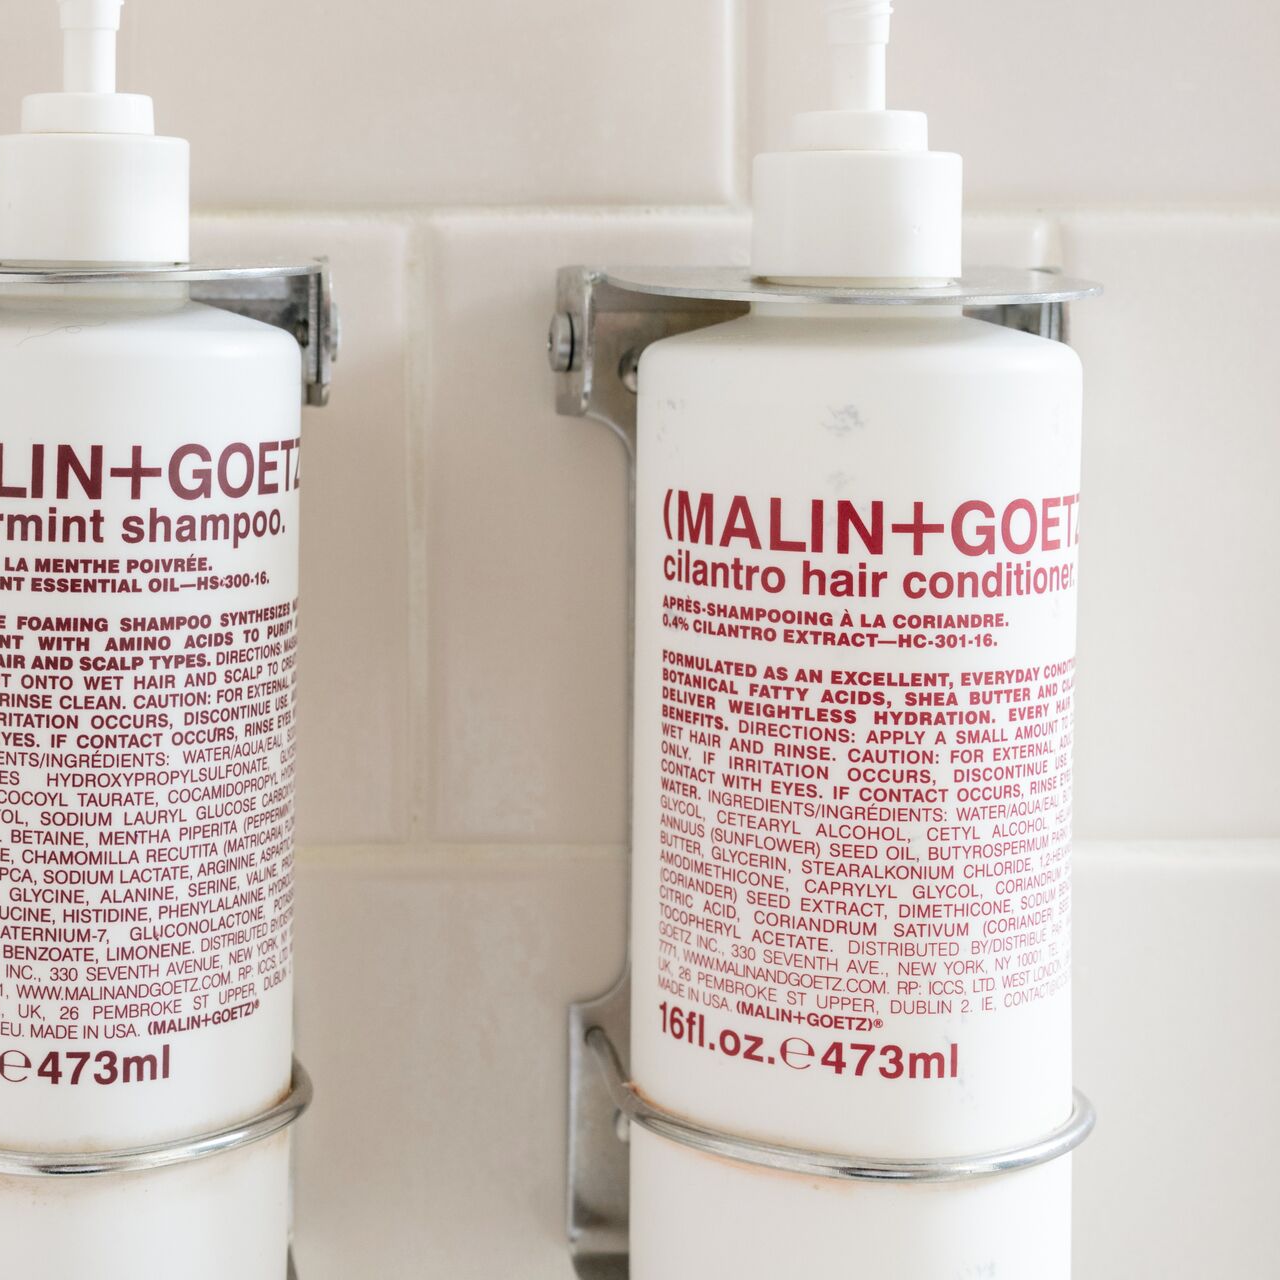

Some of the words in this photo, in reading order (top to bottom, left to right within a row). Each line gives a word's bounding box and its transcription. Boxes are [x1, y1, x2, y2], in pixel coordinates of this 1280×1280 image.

[121, 507, 286, 550] shampoo.
[4, 556, 29, 573] LA
[34, 558, 120, 574] MENTHE
[126, 553, 213, 574] POIVRÉE.
[663, 548, 786, 594] cilantro
[802, 559, 888, 598] hair
[30, 577, 143, 594] ESSENTIAL
[16, 615, 109, 633] FOAMING
[119, 614, 212, 633] SHAMPOO
[219, 601, 291, 628] SYNTHESIZES
[662, 594, 833, 627] APRÈS-SHAMPOOING
[839, 608, 854, 628] À
[860, 613, 887, 629] LA
[892, 612, 1009, 630] CORIANDRE.
[662, 612, 690, 632] 0.4%
[692, 618, 777, 643] CILANTRO
[37, 635, 90, 652] WITH
[104, 635, 172, 652] AMINO
[183, 631, 234, 650] ACIDS
[242, 627, 260, 644] TO
[267, 618, 293, 640] PURIFY
[30, 655, 74, 671] AND
[79, 656, 144, 672] SCALP
[148, 652, 211, 671] TYPES.
[216, 641, 282, 666] DIRECTIONS:
[662, 648, 758, 678] FORMULATED
[763, 665, 789, 682] AS
[794, 668, 823, 684] AN
[830, 670, 954, 690] EXCELLENT,
[960, 666, 1040, 687] EVERYDAY
[59, 695, 126, 711] CLEAN.
[133, 690, 211, 710] CAUTION:
[216, 686, 243, 704] FOR
[662, 667, 739, 696] BOTANICAL
[749, 682, 809, 702] FATTY
[820, 688, 892, 710] ACIDS,
[904, 691, 959, 707] SHEA
[969, 687, 1031, 706] BUTTER
[1037, 682, 1058, 700] AND
[662, 685, 716, 711] DELIVER
[728, 699, 857, 725] WEIGHTLESS
[874, 709, 996, 726] HYDRATION.
[1008, 703, 1050, 723] EVERY
[662, 703, 729, 732] BENEFITS.
[738, 719, 855, 744] DIRECTIONS:
[865, 729, 926, 745] APPLY
[934, 730, 947, 745] A
[955, 727, 1009, 745] SMALL
[1014, 718, 1059, 741] AMOUNT
[661, 722, 684, 741] WET
[689, 729, 721, 749] HAIR
[729, 737, 764, 755] AND
[774, 742, 836, 762] RINSE.
[847, 747, 940, 765] CAUTION:
[950, 748, 984, 765] FOR
[10, 828, 89, 849] BETAINE,
[98, 828, 171, 846] MENTHA
[179, 819, 238, 842] PIPERITA
[660, 829, 704, 859] BUTTER,
[711, 845, 791, 874] GLYCERIN,
[801, 859, 954, 881] STEARALKONIUM
[963, 856, 1034, 880] CHLORIDE,
[659, 849, 789, 893] AMODIMETHICONE,
[804, 878, 898, 899] CAPRYLYL
[912, 883, 983, 900] GLYCOL,
[657, 974, 685, 999] MADE
[687, 986, 700, 1004] IN
[30, 1023, 78, 1040] MADE
[83, 1024, 99, 1040] IN
